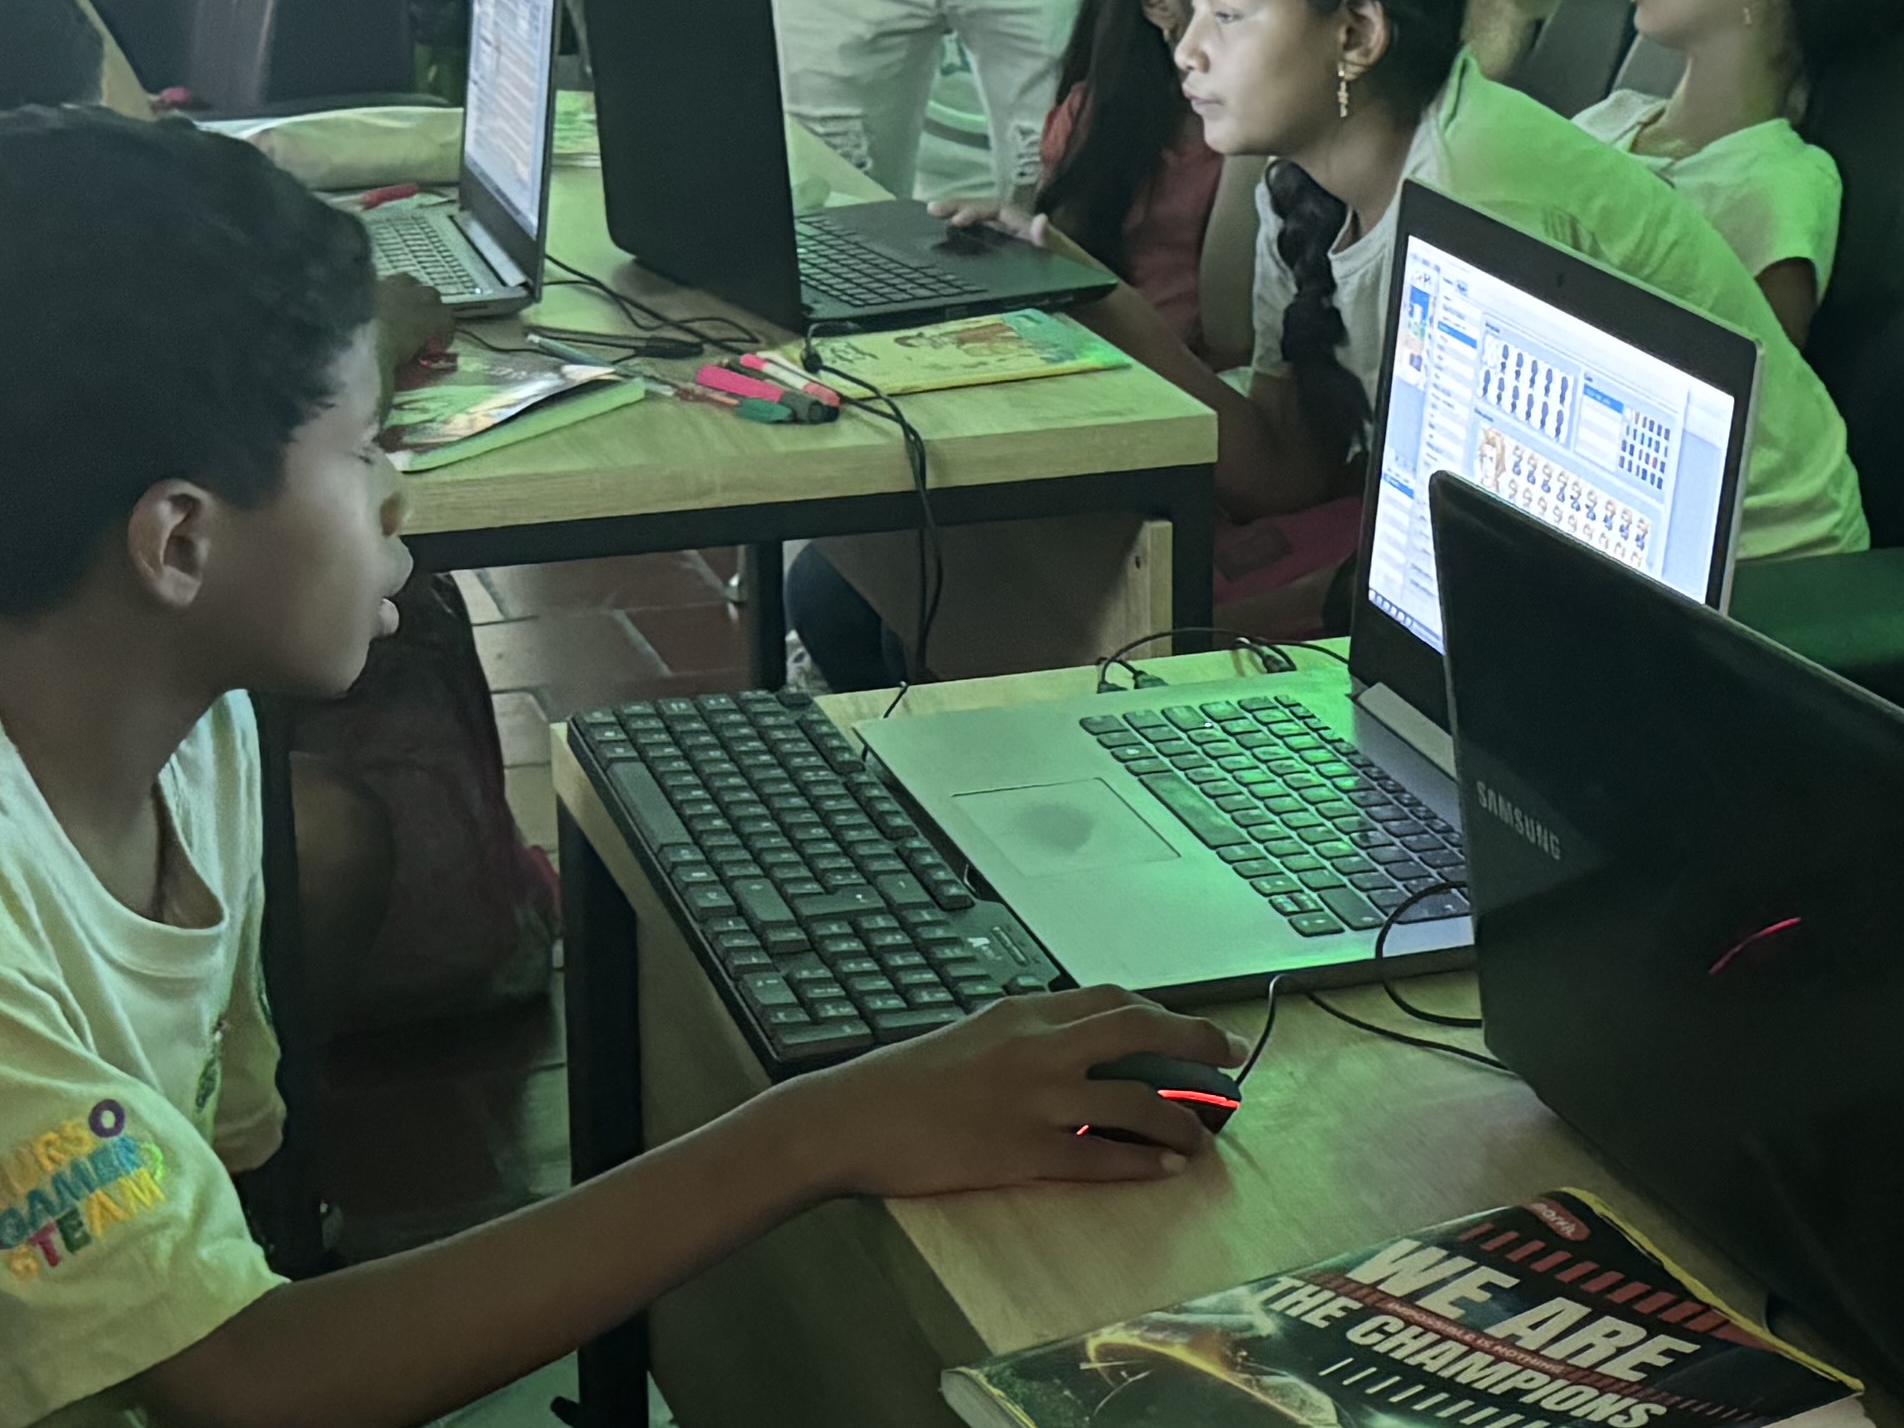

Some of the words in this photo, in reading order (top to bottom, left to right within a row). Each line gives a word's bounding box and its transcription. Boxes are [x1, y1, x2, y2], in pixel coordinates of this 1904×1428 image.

[1475, 779, 1563, 862] SAMSUNG
[1248, 1276, 1363, 1329] THE
[1345, 1314, 1668, 1428] CHAMPIONS
[1346, 1238, 1520, 1320] WE
[1485, 1296, 1701, 1382] ARE
